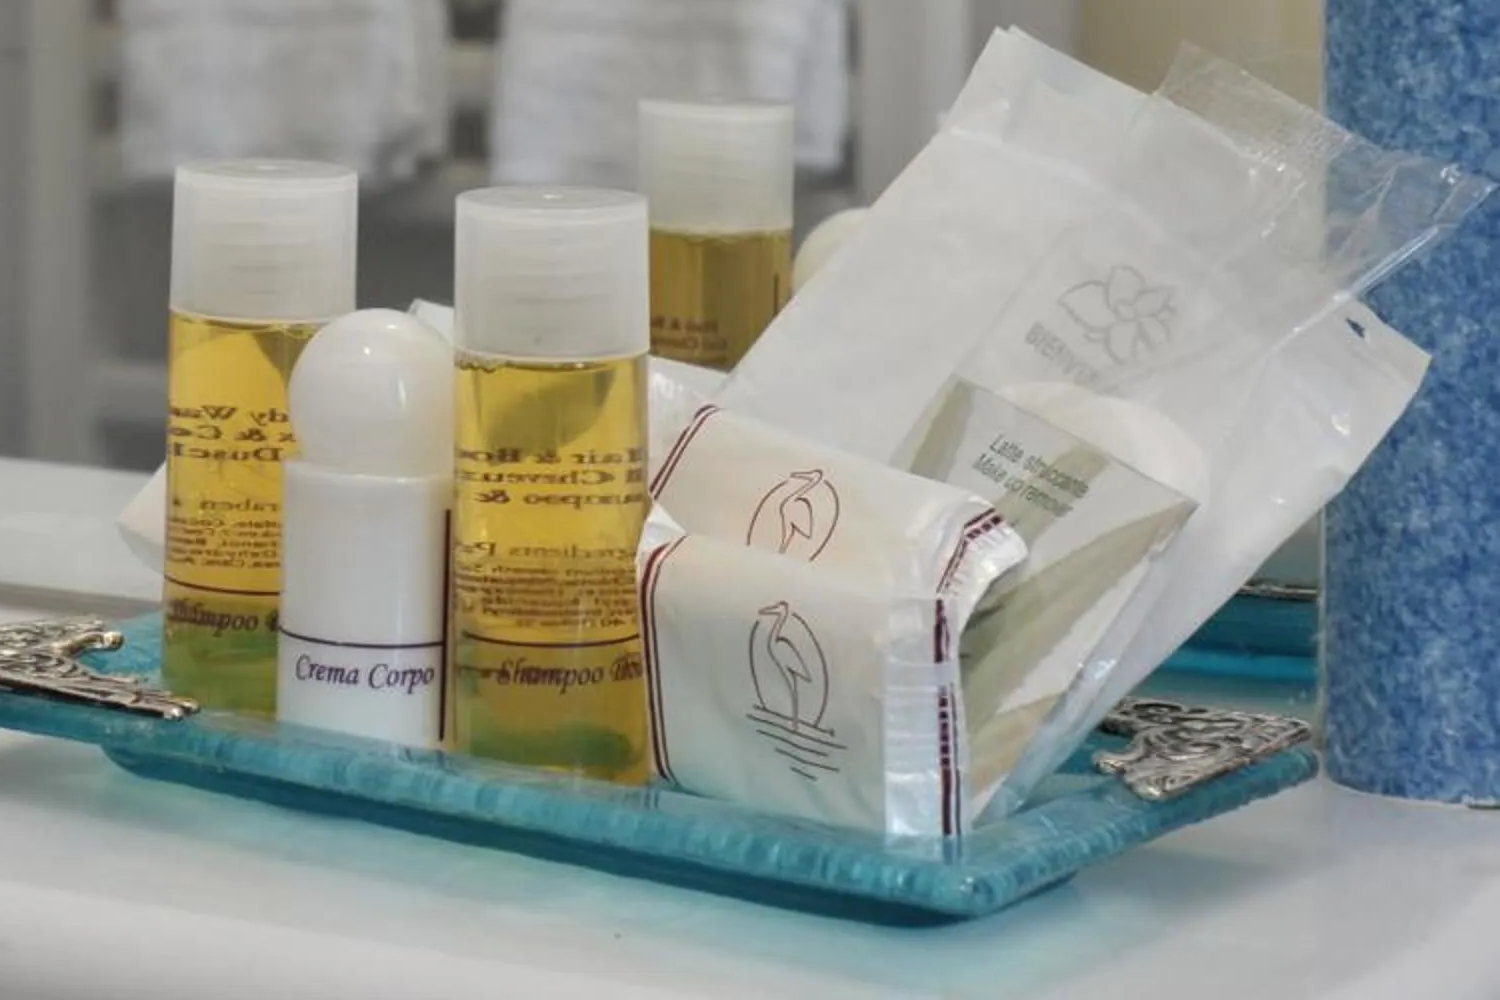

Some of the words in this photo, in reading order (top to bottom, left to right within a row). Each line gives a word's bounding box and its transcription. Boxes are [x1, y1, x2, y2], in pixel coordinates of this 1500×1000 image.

[295, 652, 359, 686] Crema
[367, 662, 435, 695] Corpo
[496, 656, 605, 695] Shampoo
